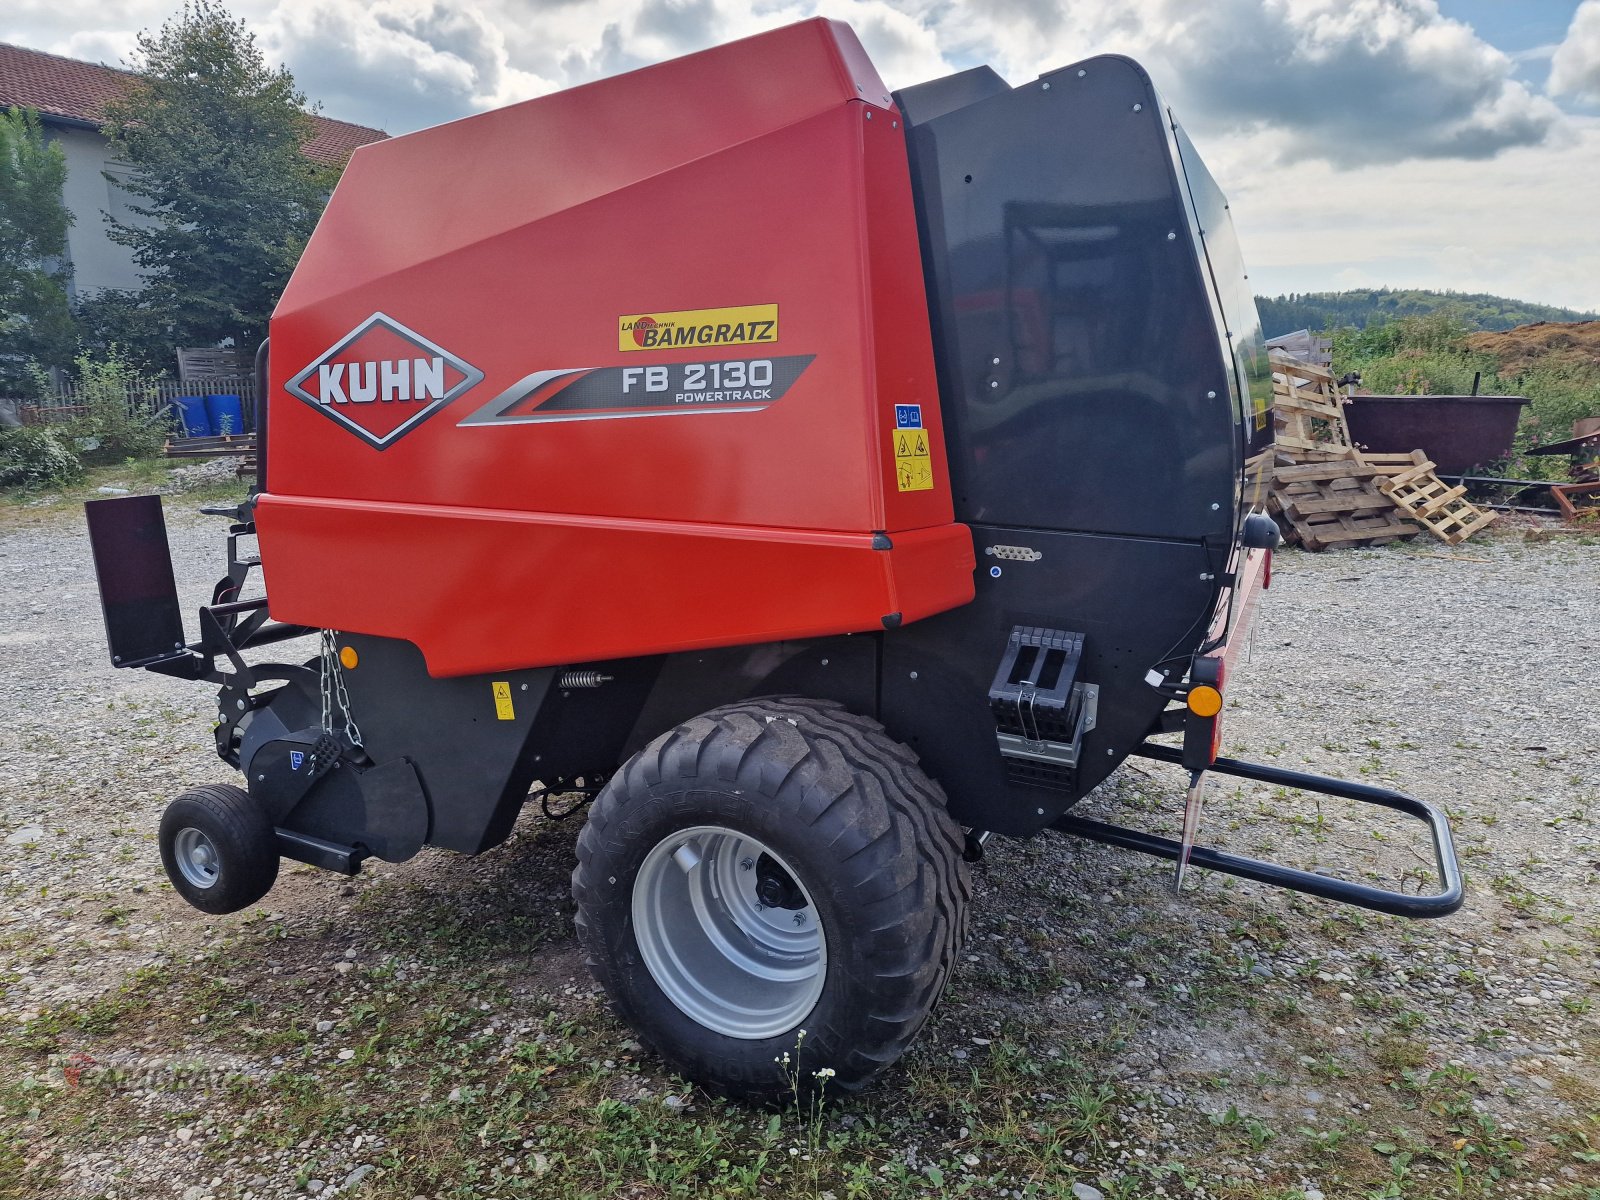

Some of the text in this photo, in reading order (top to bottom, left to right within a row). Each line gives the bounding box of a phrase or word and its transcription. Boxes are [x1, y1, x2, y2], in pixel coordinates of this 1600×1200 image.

[642, 320, 775, 348] BAMGRATZ
[318, 357, 445, 405] KUHN
[622, 359, 773, 393] FB 2130
[675, 389, 772, 403] POWERTRACK
